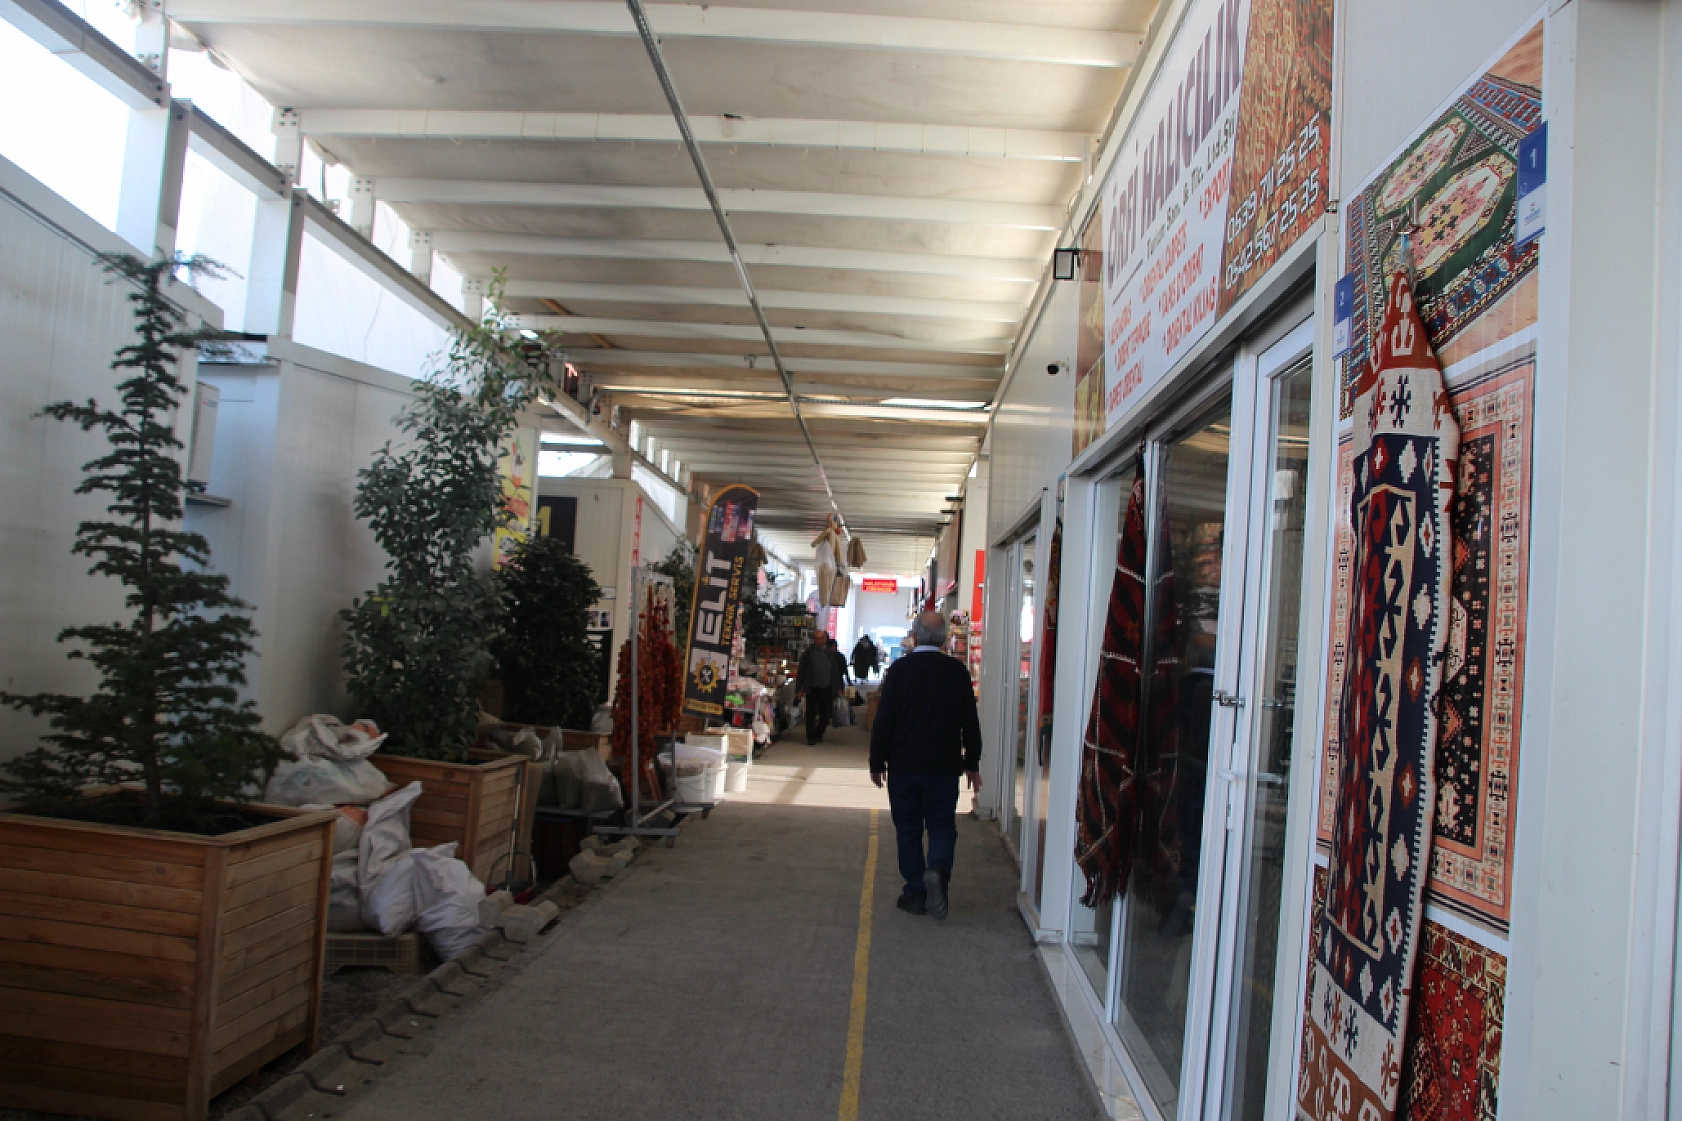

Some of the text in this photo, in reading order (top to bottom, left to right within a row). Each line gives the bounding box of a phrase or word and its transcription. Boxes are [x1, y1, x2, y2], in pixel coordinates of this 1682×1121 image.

[1141, 0, 1242, 239] HALICILIK
[1227, 113, 1320, 245] 0539 711 25 25
[1530, 148, 1537, 168] 1
[1226, 168, 1320, 291] 0542 567 25 35
[695, 550, 732, 645] ELİT
